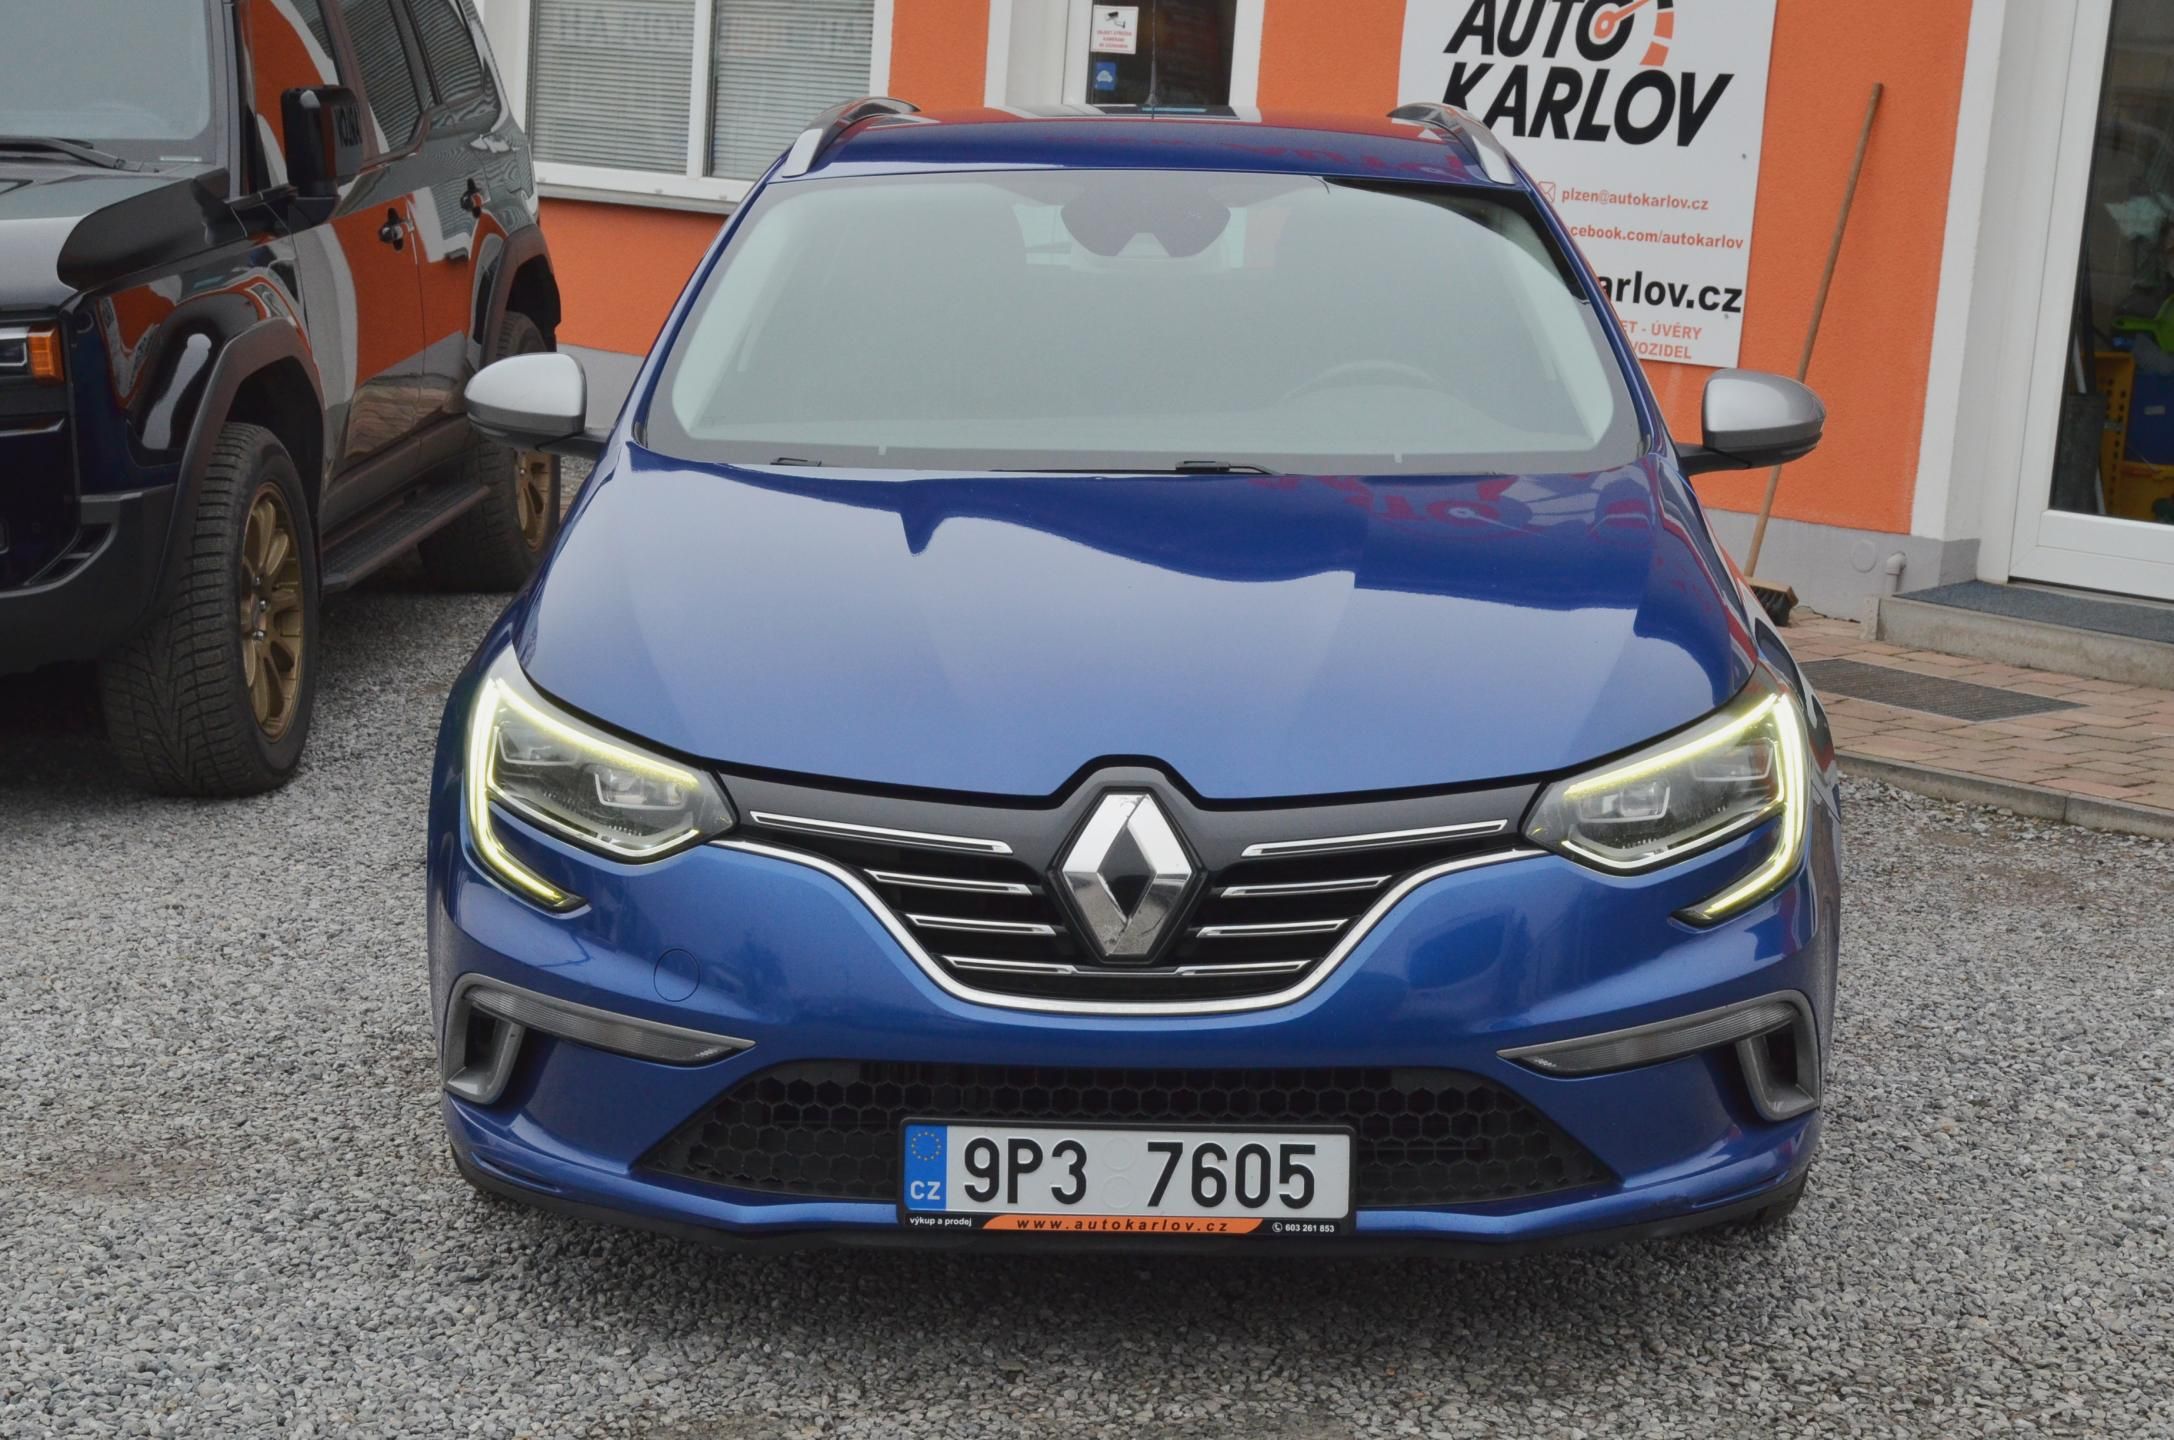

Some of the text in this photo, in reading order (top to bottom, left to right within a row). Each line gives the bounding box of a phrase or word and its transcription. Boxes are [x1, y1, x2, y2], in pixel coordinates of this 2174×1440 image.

[1443, 0, 1635, 62] AUTO
[1442, 62, 1735, 147] KARLOV
[1562, 188, 1709, 211] plzen@autokarlov.cz
[1569, 224, 1744, 249] cebook.com/autokarlov
[1598, 270, 1743, 313] arlov.cz
[964, 1137, 1316, 1209] 9P3 7605
[910, 1180, 941, 1200] CZ
[910, 1215, 936, 1226] výkup
[945, 1216, 972, 1228] prodej
[1016, 1217, 1229, 1232] www.autokarlov.cz
[1285, 1223, 1335, 1233] 603 261 853
